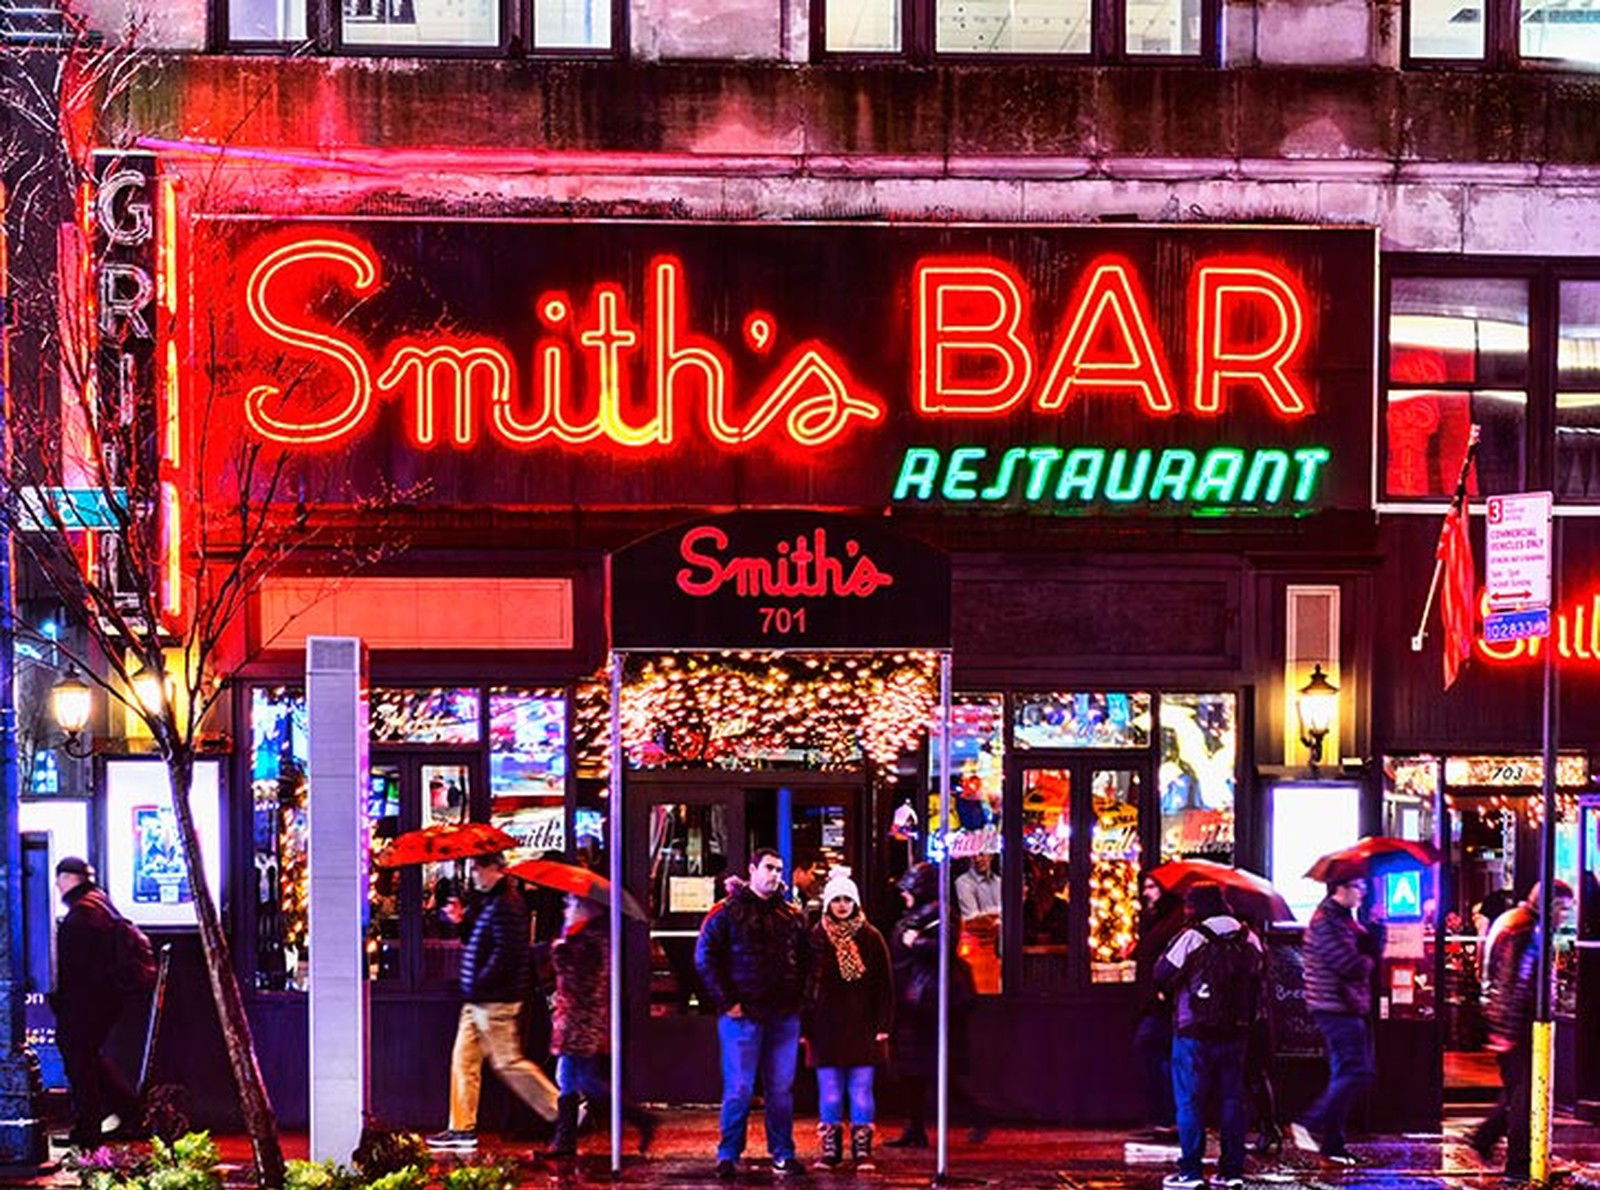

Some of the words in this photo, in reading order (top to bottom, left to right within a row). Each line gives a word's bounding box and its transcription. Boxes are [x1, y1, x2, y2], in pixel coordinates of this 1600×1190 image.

[245, 238, 882, 447] Smith's
[919, 264, 1305, 413] BAR
[893, 448, 1331, 501] RESTAURANT
[1489, 500, 1501, 521] 3
[676, 525, 893, 598] Smith's
[758, 607, 807, 633] 701
[1492, 767, 1524, 781] 703
[1392, 875, 1416, 905] A
